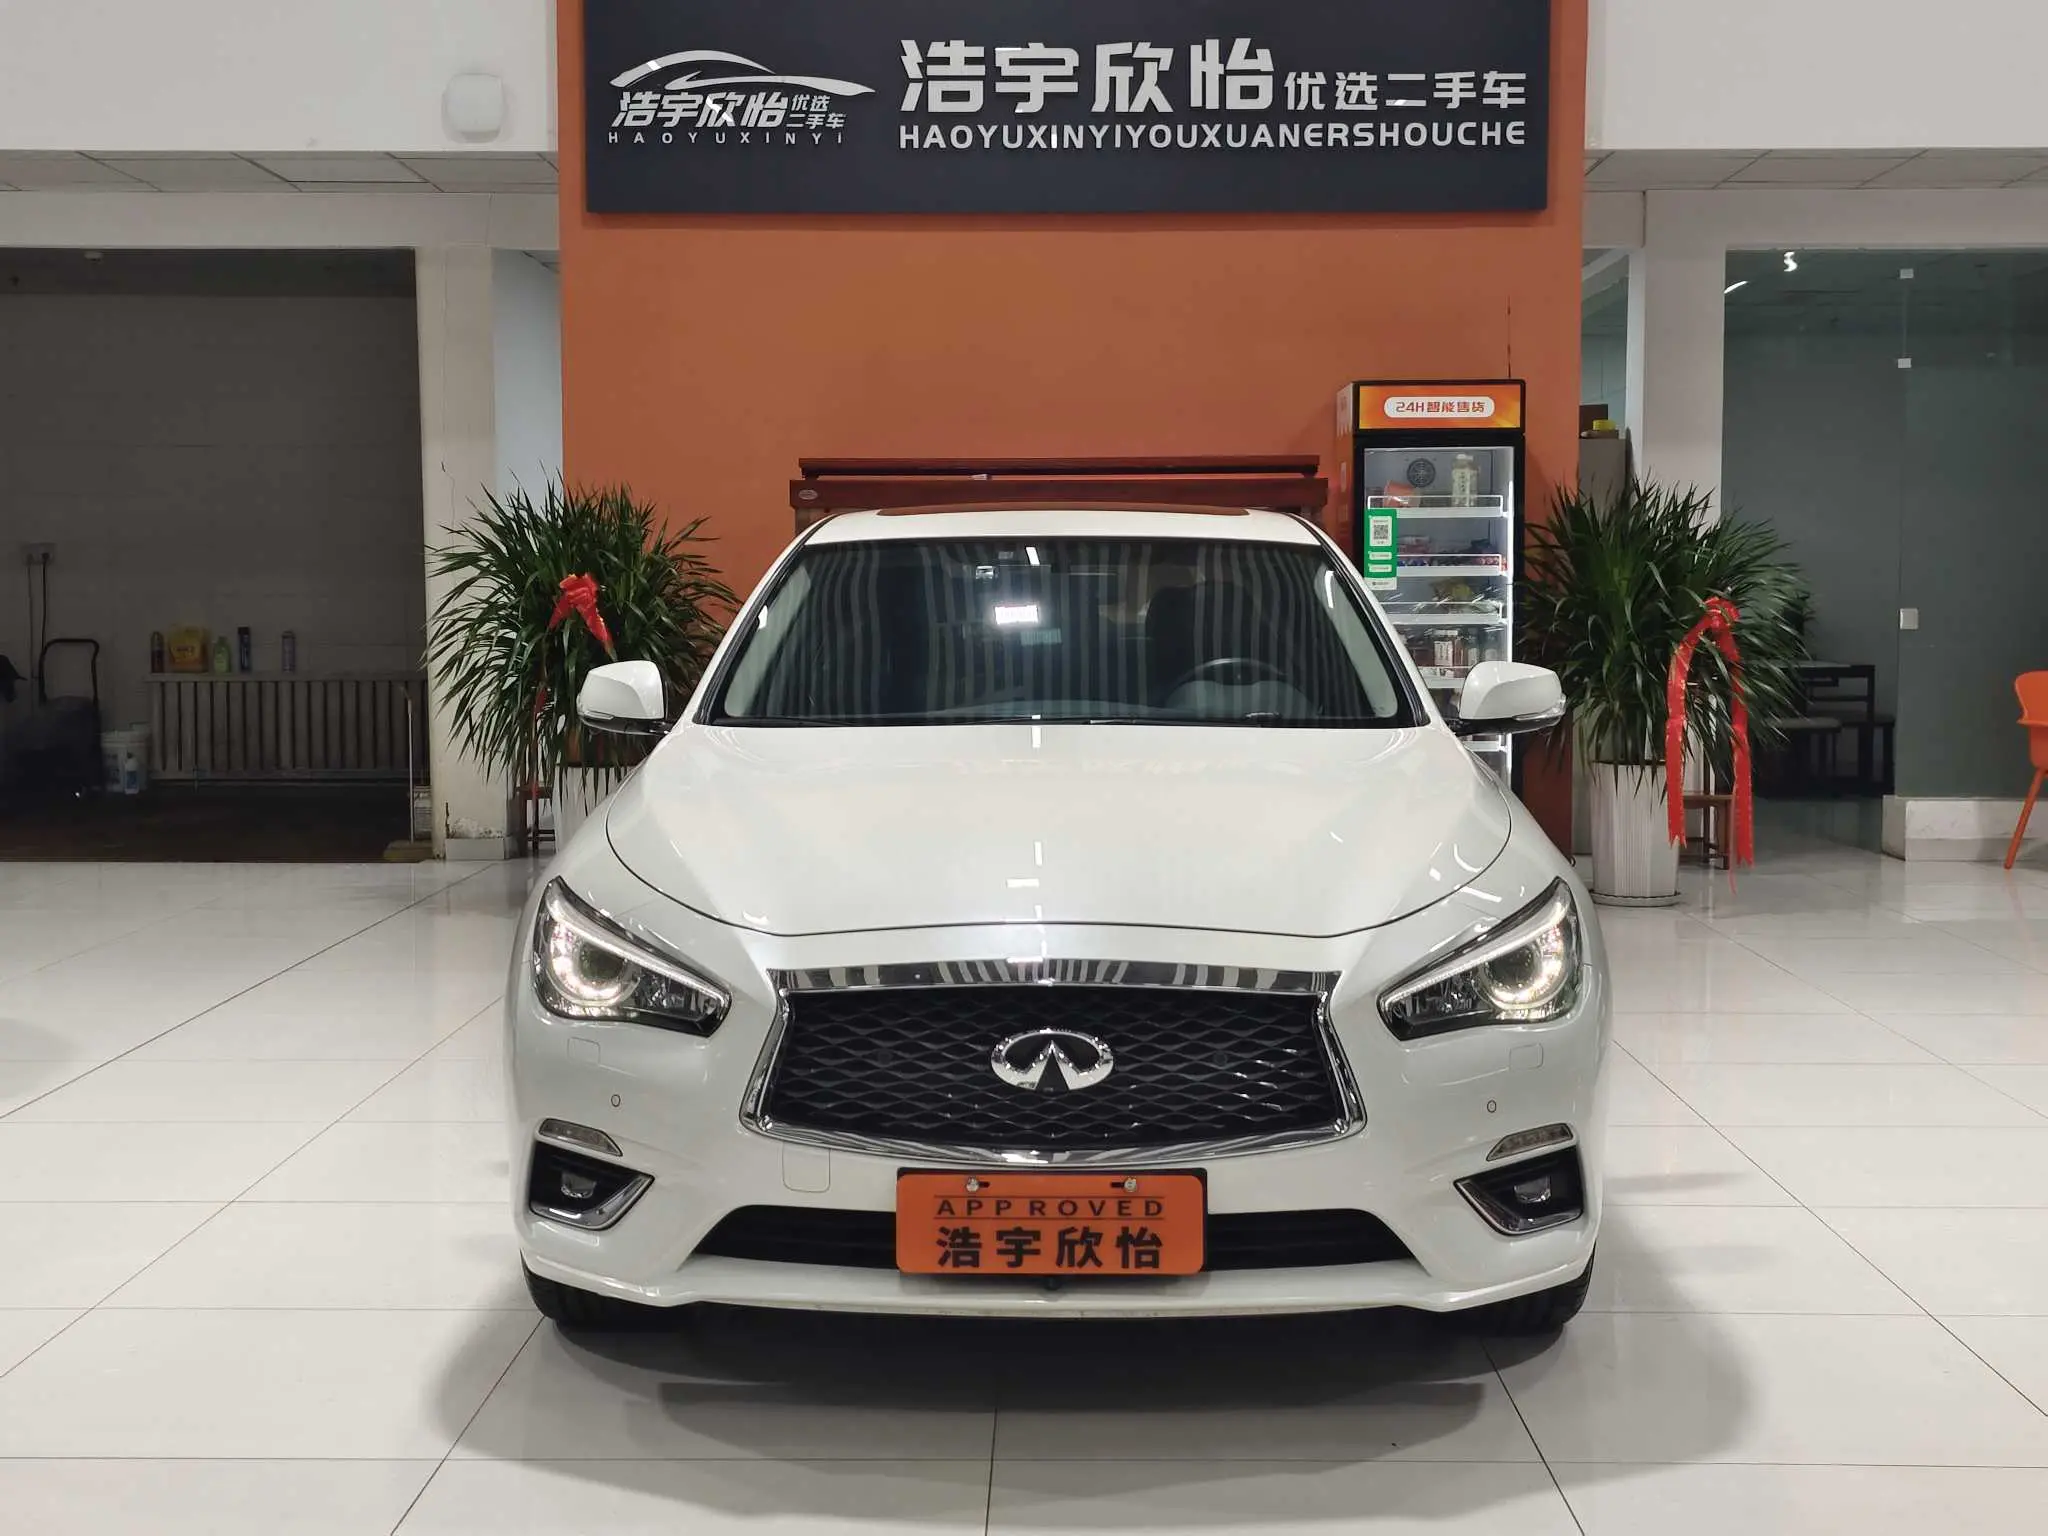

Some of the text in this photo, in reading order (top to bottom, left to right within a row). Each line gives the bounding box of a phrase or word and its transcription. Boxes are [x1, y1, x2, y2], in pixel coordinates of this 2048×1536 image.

[901, 37, 1527, 114] 浩宇欣怡 优选二手车
[611, 91, 788, 128] 浩宇欣怡
[791, 94, 831, 112] 优选
[786, 113, 846, 130] 二手车
[608, 131, 843, 145] HAOYUXINYI
[899, 120, 1526, 150] HAOYUXINYIYOUXUANERSHOUCHE
[936, 1199, 1163, 1217] APPROVED
[936, 1225, 1163, 1269] 浩宇欣怡
